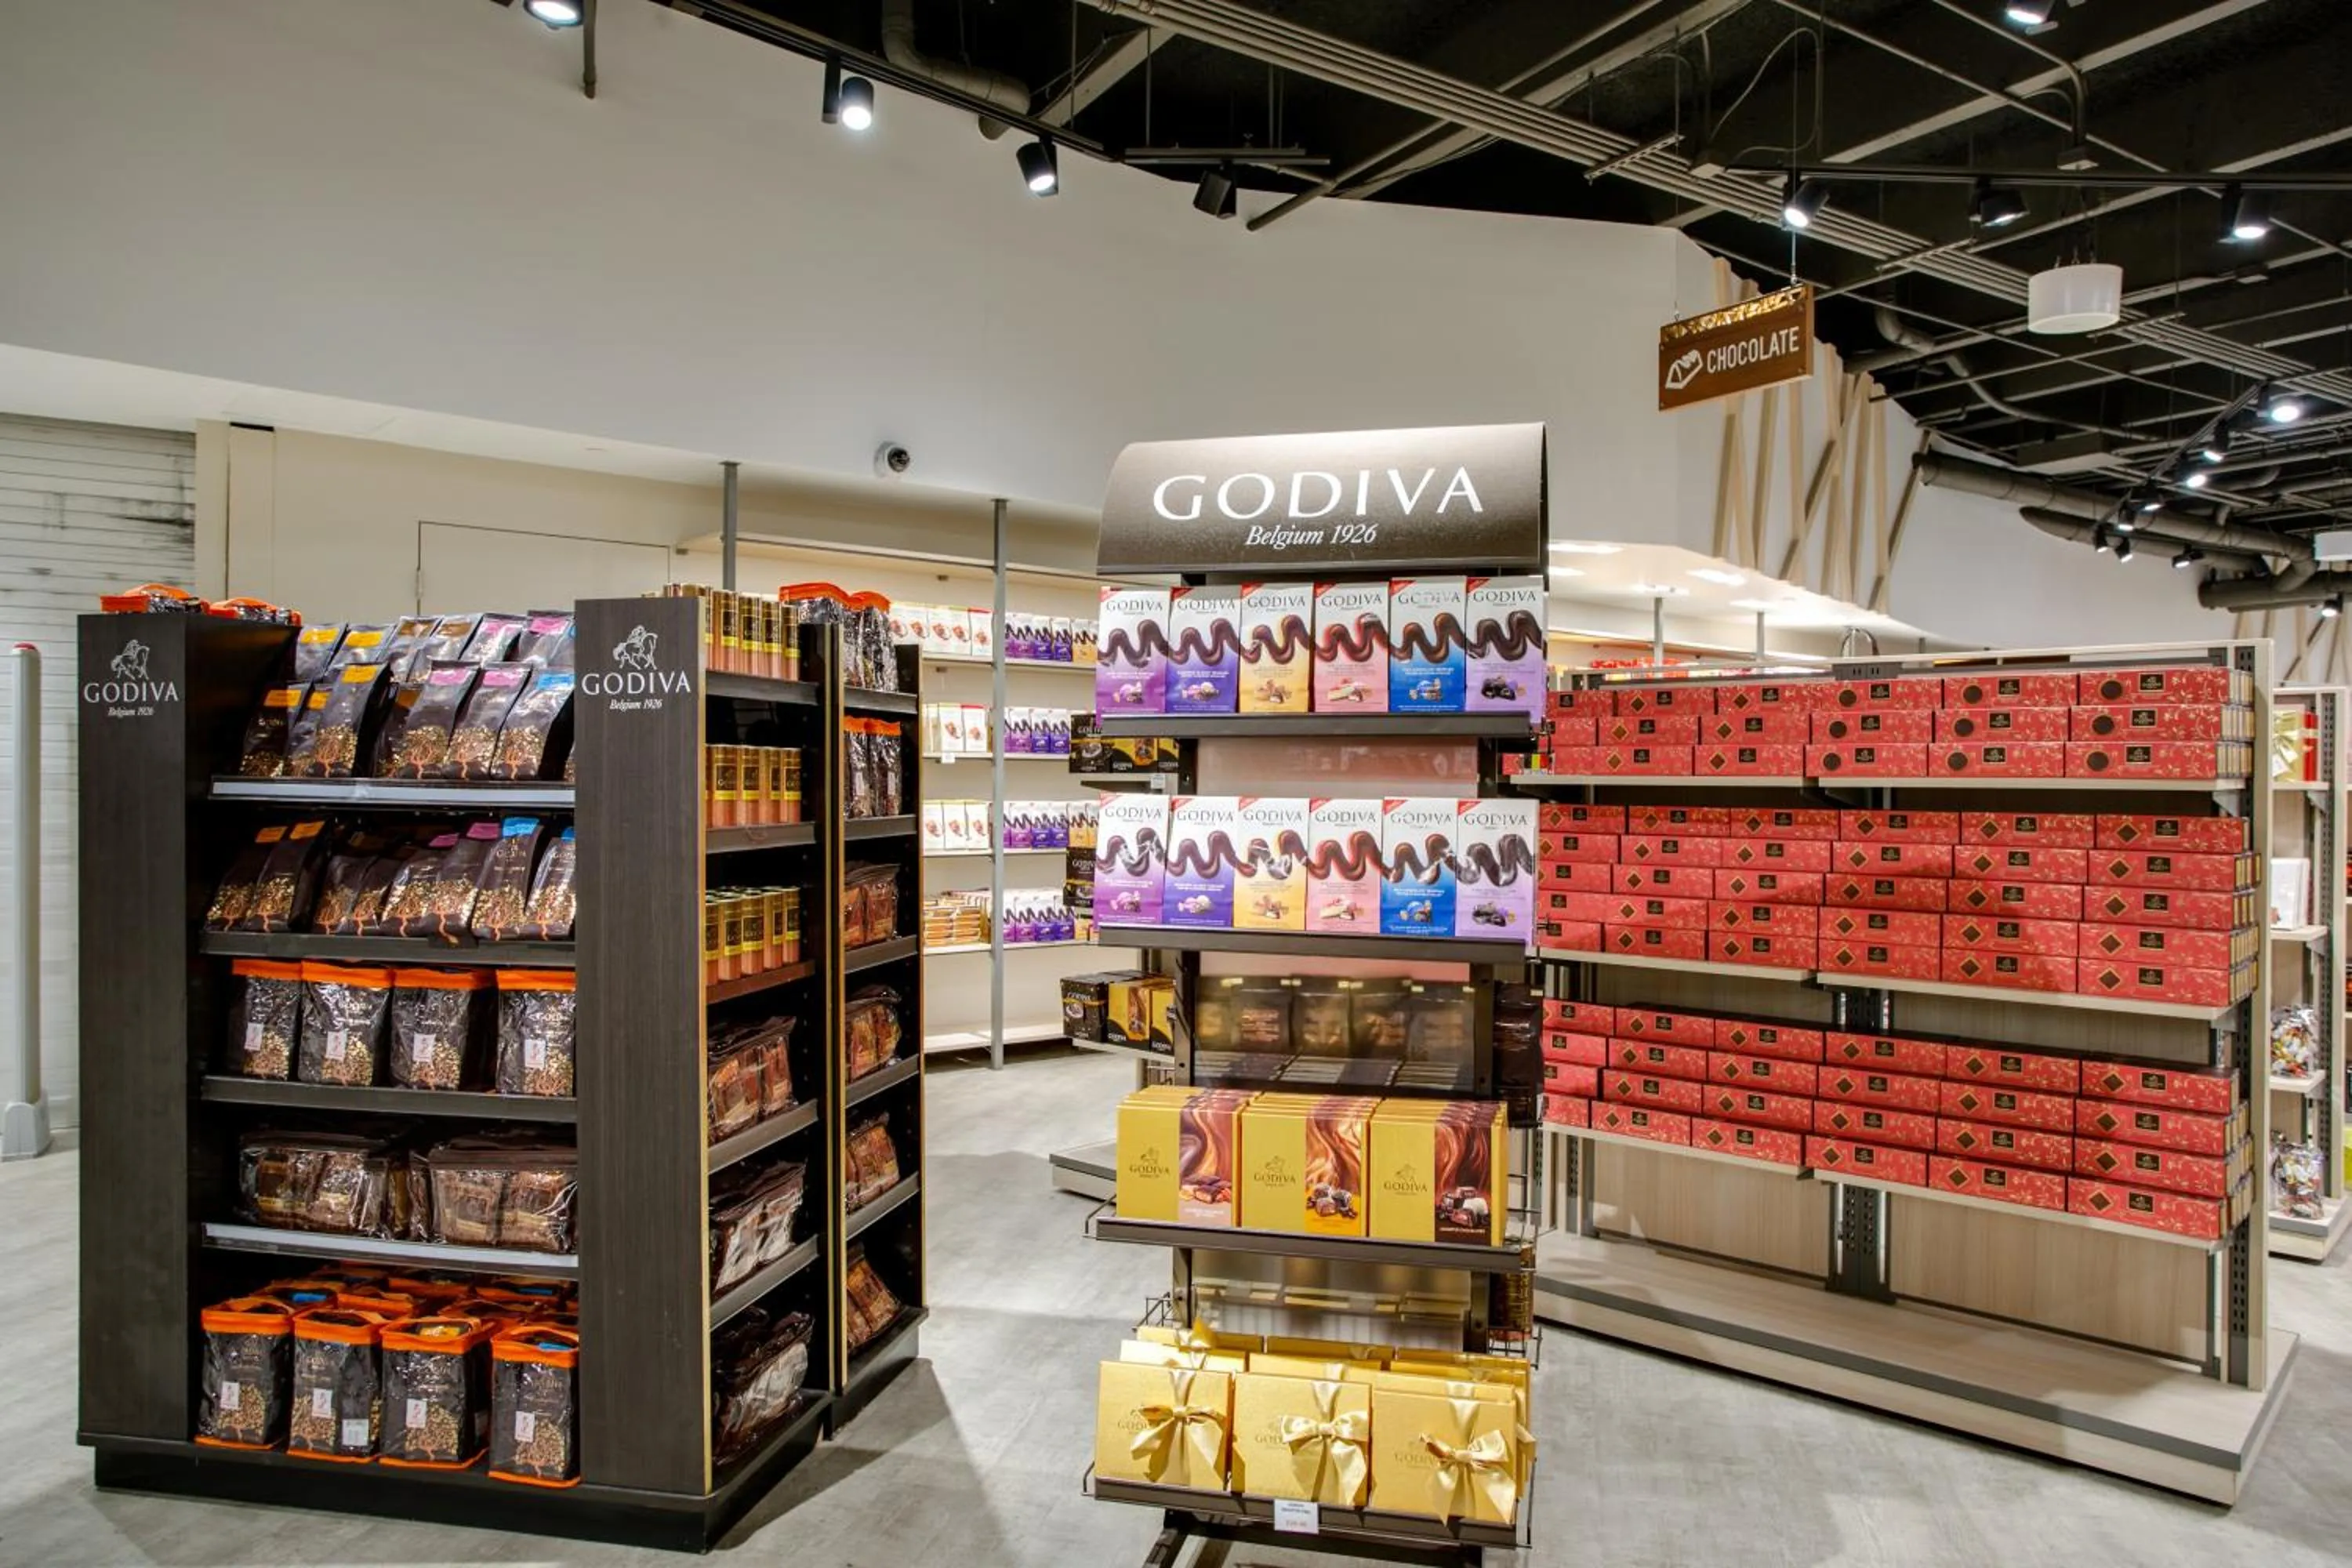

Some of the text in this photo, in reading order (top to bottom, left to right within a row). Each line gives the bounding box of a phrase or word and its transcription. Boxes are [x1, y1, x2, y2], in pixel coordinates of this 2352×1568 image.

[1706, 325, 1800, 374] CHOCOLATE
[1153, 466, 1483, 521] GODIVA
[1245, 524, 1379, 550] Belgium 1926
[1247, 595, 1305, 608] GODIVA
[1321, 593, 1382, 606] GODIVA
[1473, 590, 1536, 603] GODIVA
[1106, 600, 1163, 612] GODIVA
[1178, 598, 1236, 611] GODIVA
[582, 670, 691, 695] GODIVA
[84, 682, 179, 703] GODIVA
[1105, 807, 1162, 818] GODIVA
[1177, 811, 1234, 822] GODIVA
[1243, 810, 1302, 822] GODIVA
[1315, 811, 1377, 823] GODIVA
[1390, 811, 1451, 824] GODIVA
[1464, 813, 1528, 826] GODIVA
[1129, 1165, 1171, 1174] GODIVA
[1254, 1173, 1296, 1184] GODIVA
[1383, 1181, 1428, 1192] GODIVA
